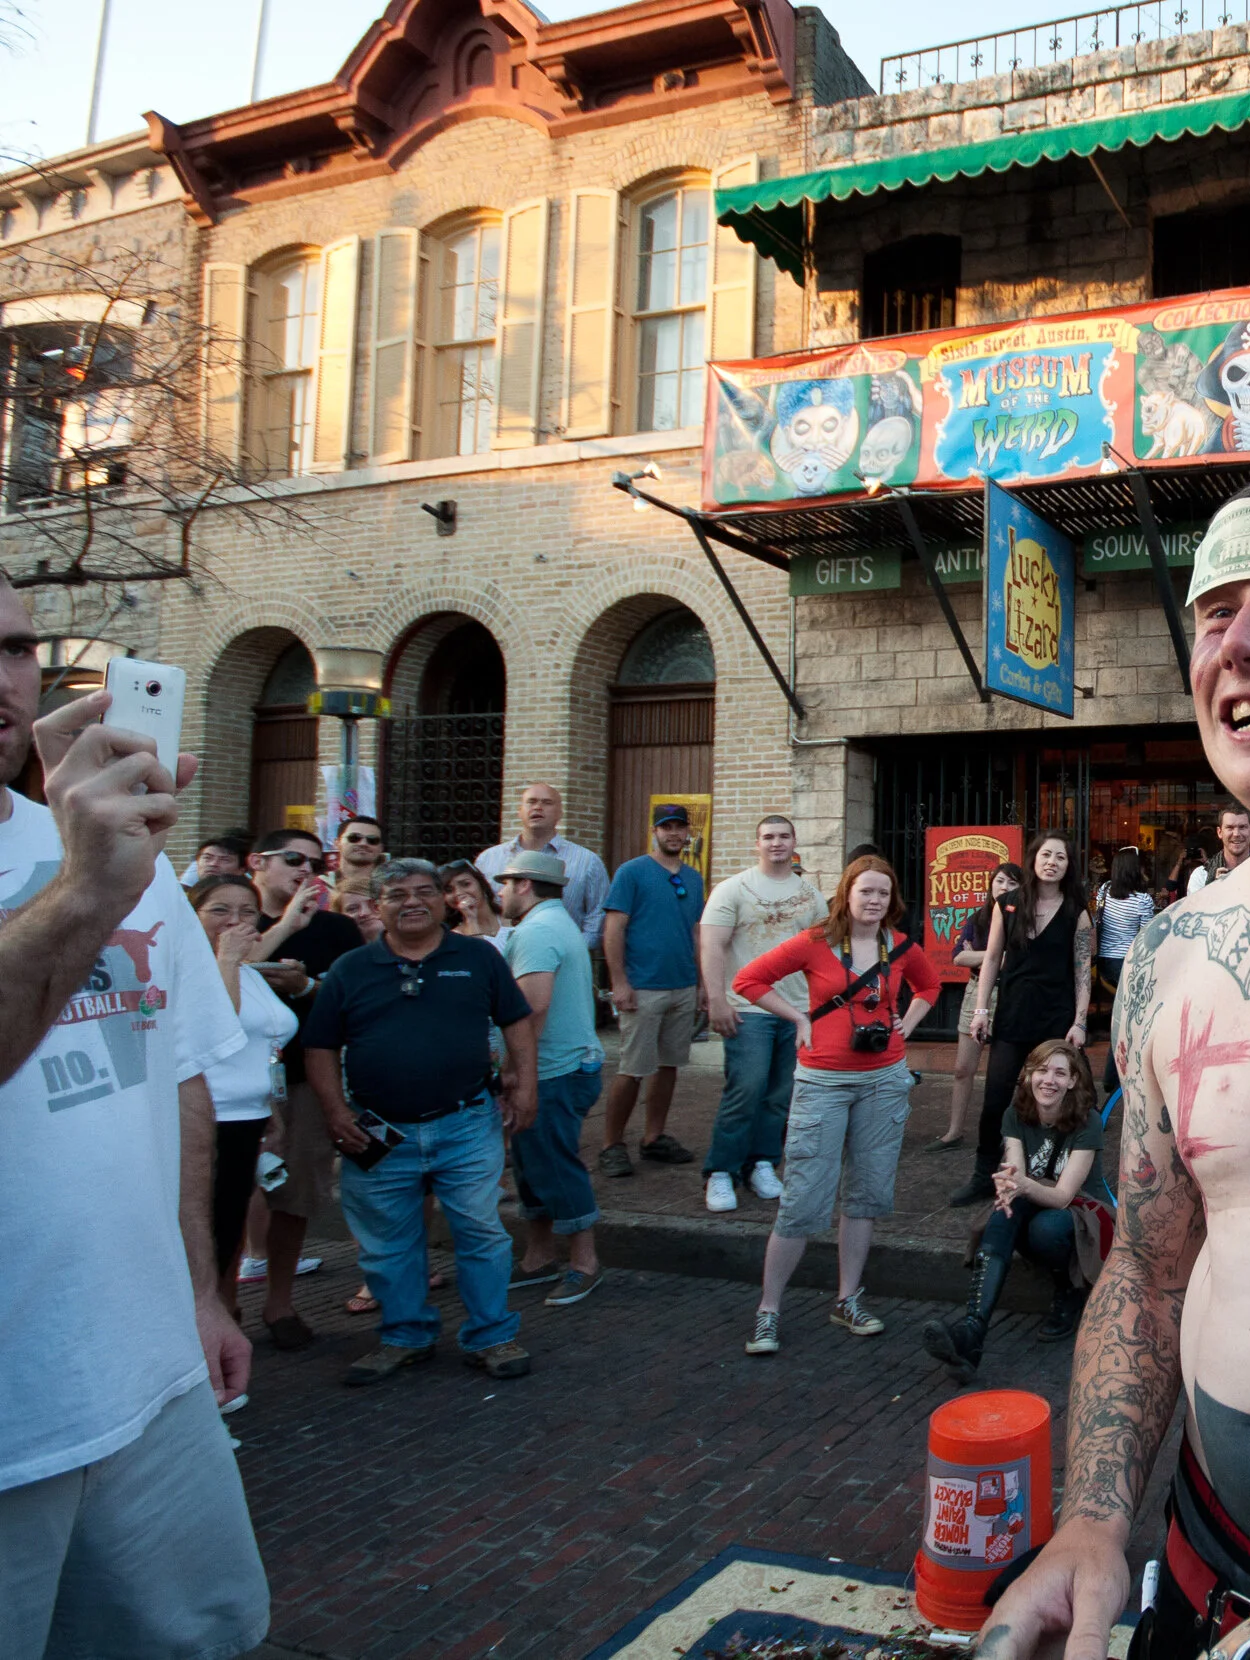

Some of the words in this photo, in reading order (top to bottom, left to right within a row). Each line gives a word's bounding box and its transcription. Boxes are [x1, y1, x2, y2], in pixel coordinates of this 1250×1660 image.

[940, 341, 978, 362] Sixth
[984, 334, 1031, 353] Street,
[1036, 325, 1089, 345] Austin,
[1097, 323, 1119, 339] TX
[958, 352, 1093, 410] MUSEUM
[1000, 396, 1019, 409] OF
[1026, 392, 1050, 405] THE
[973, 408, 1079, 468] WEIRD
[935, 548, 980, 574] ANTI
[1092, 531, 1203, 561] SOUVNIRS
[816, 556, 874, 585] GIFTS
[1008, 527, 1060, 608] Lucky
[1005, 582, 1060, 666] Lizard
[953, 893, 969, 903] OF
[974, 892, 988, 902] TH
[60, 992, 127, 1022] OTBALL
[40, 1050, 110, 1094] no.
[934, 1484, 973, 1508] BUCKET
[936, 1506, 968, 1525] PAINT
[934, 1521, 970, 1545] HOMER
